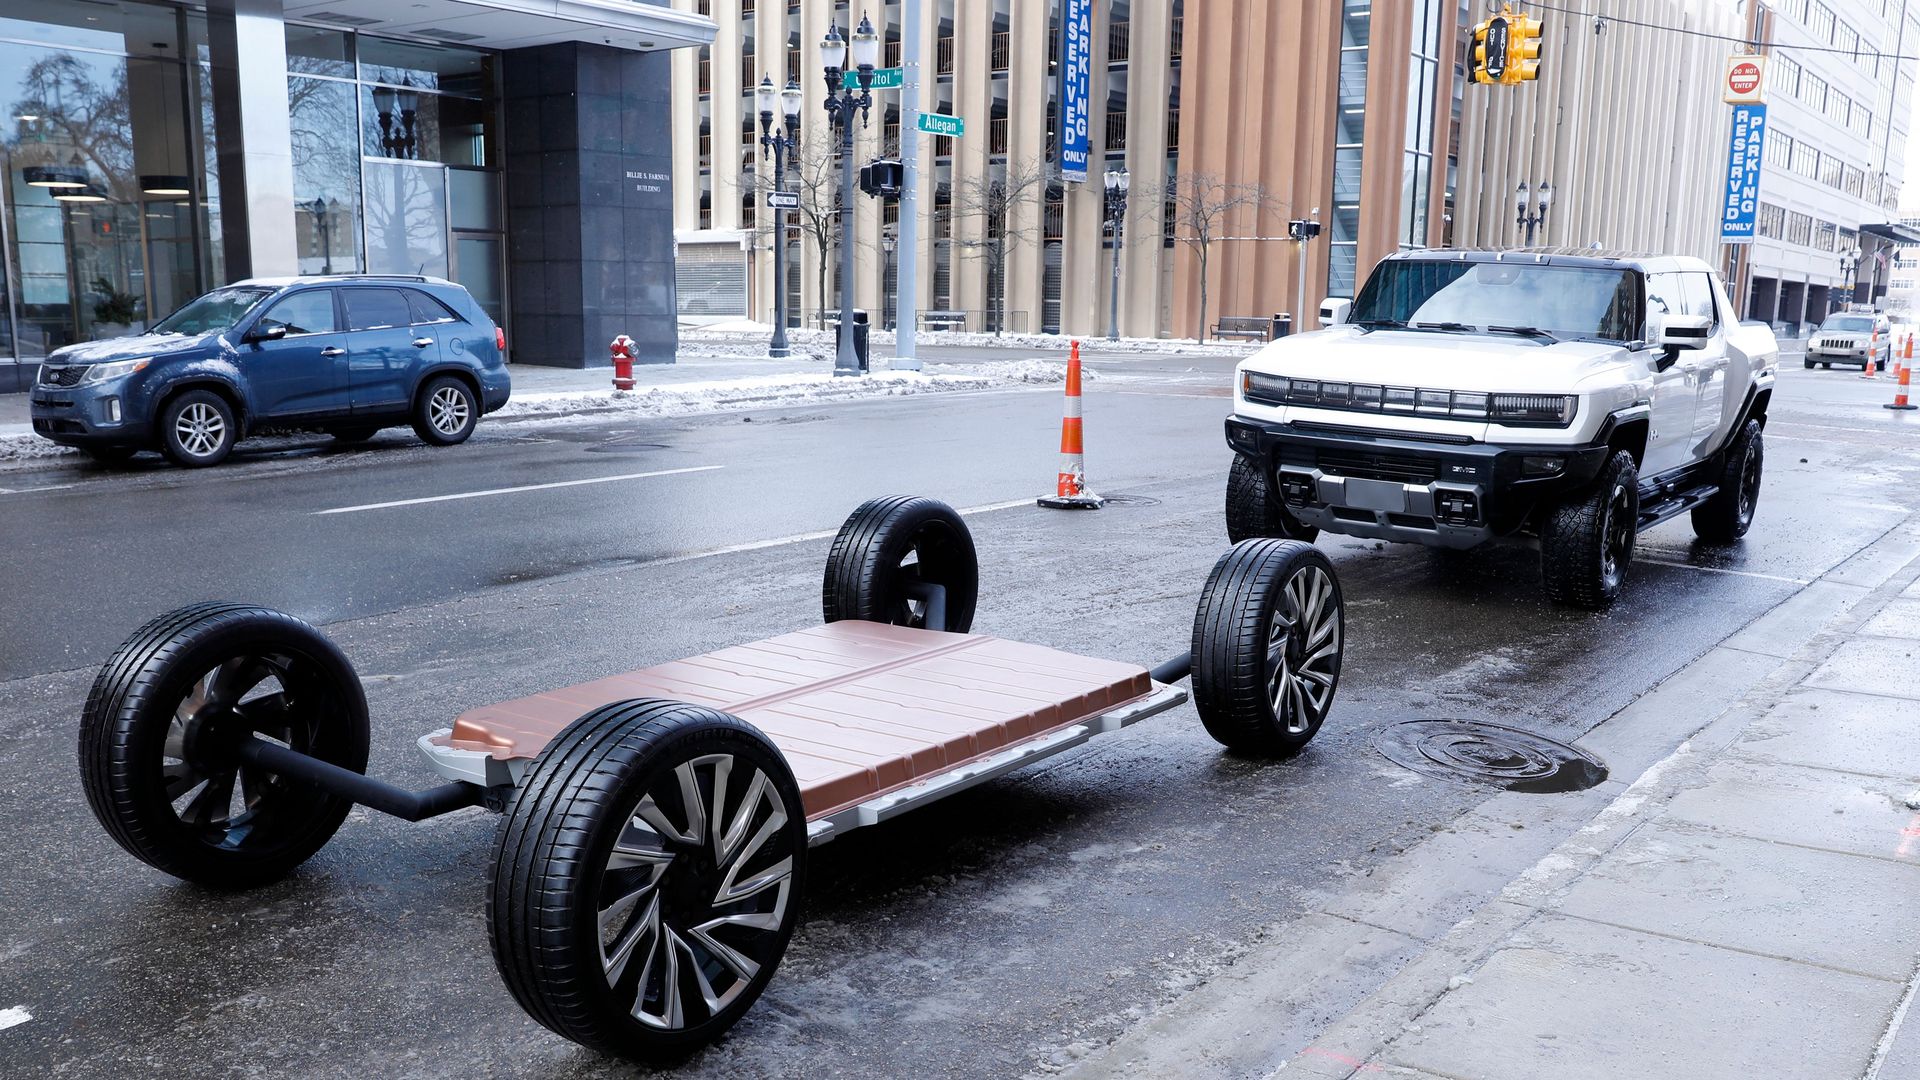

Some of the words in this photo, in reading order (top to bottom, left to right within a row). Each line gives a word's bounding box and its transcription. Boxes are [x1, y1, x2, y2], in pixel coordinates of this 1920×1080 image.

[1076, 0, 1090, 136] PARKING
[1488, 56, 1493, 68] OF
[855, 72, 890, 86] Citol
[1065, 0, 1079, 145] ESERVED
[925, 114, 956, 133] Allegan
[1064, 150, 1086, 163] ONLY
[1726, 109, 1749, 220] RESERVED
[1741, 116, 1763, 214] PARKING
[626, 171, 642, 179] BILLIE
[648, 173, 670, 181] FARNUM
[636, 184, 661, 192] BUILDING
[776, 196, 785, 204] ONE
[786, 196, 796, 205] WAY
[1724, 222, 1753, 231] ONLY
